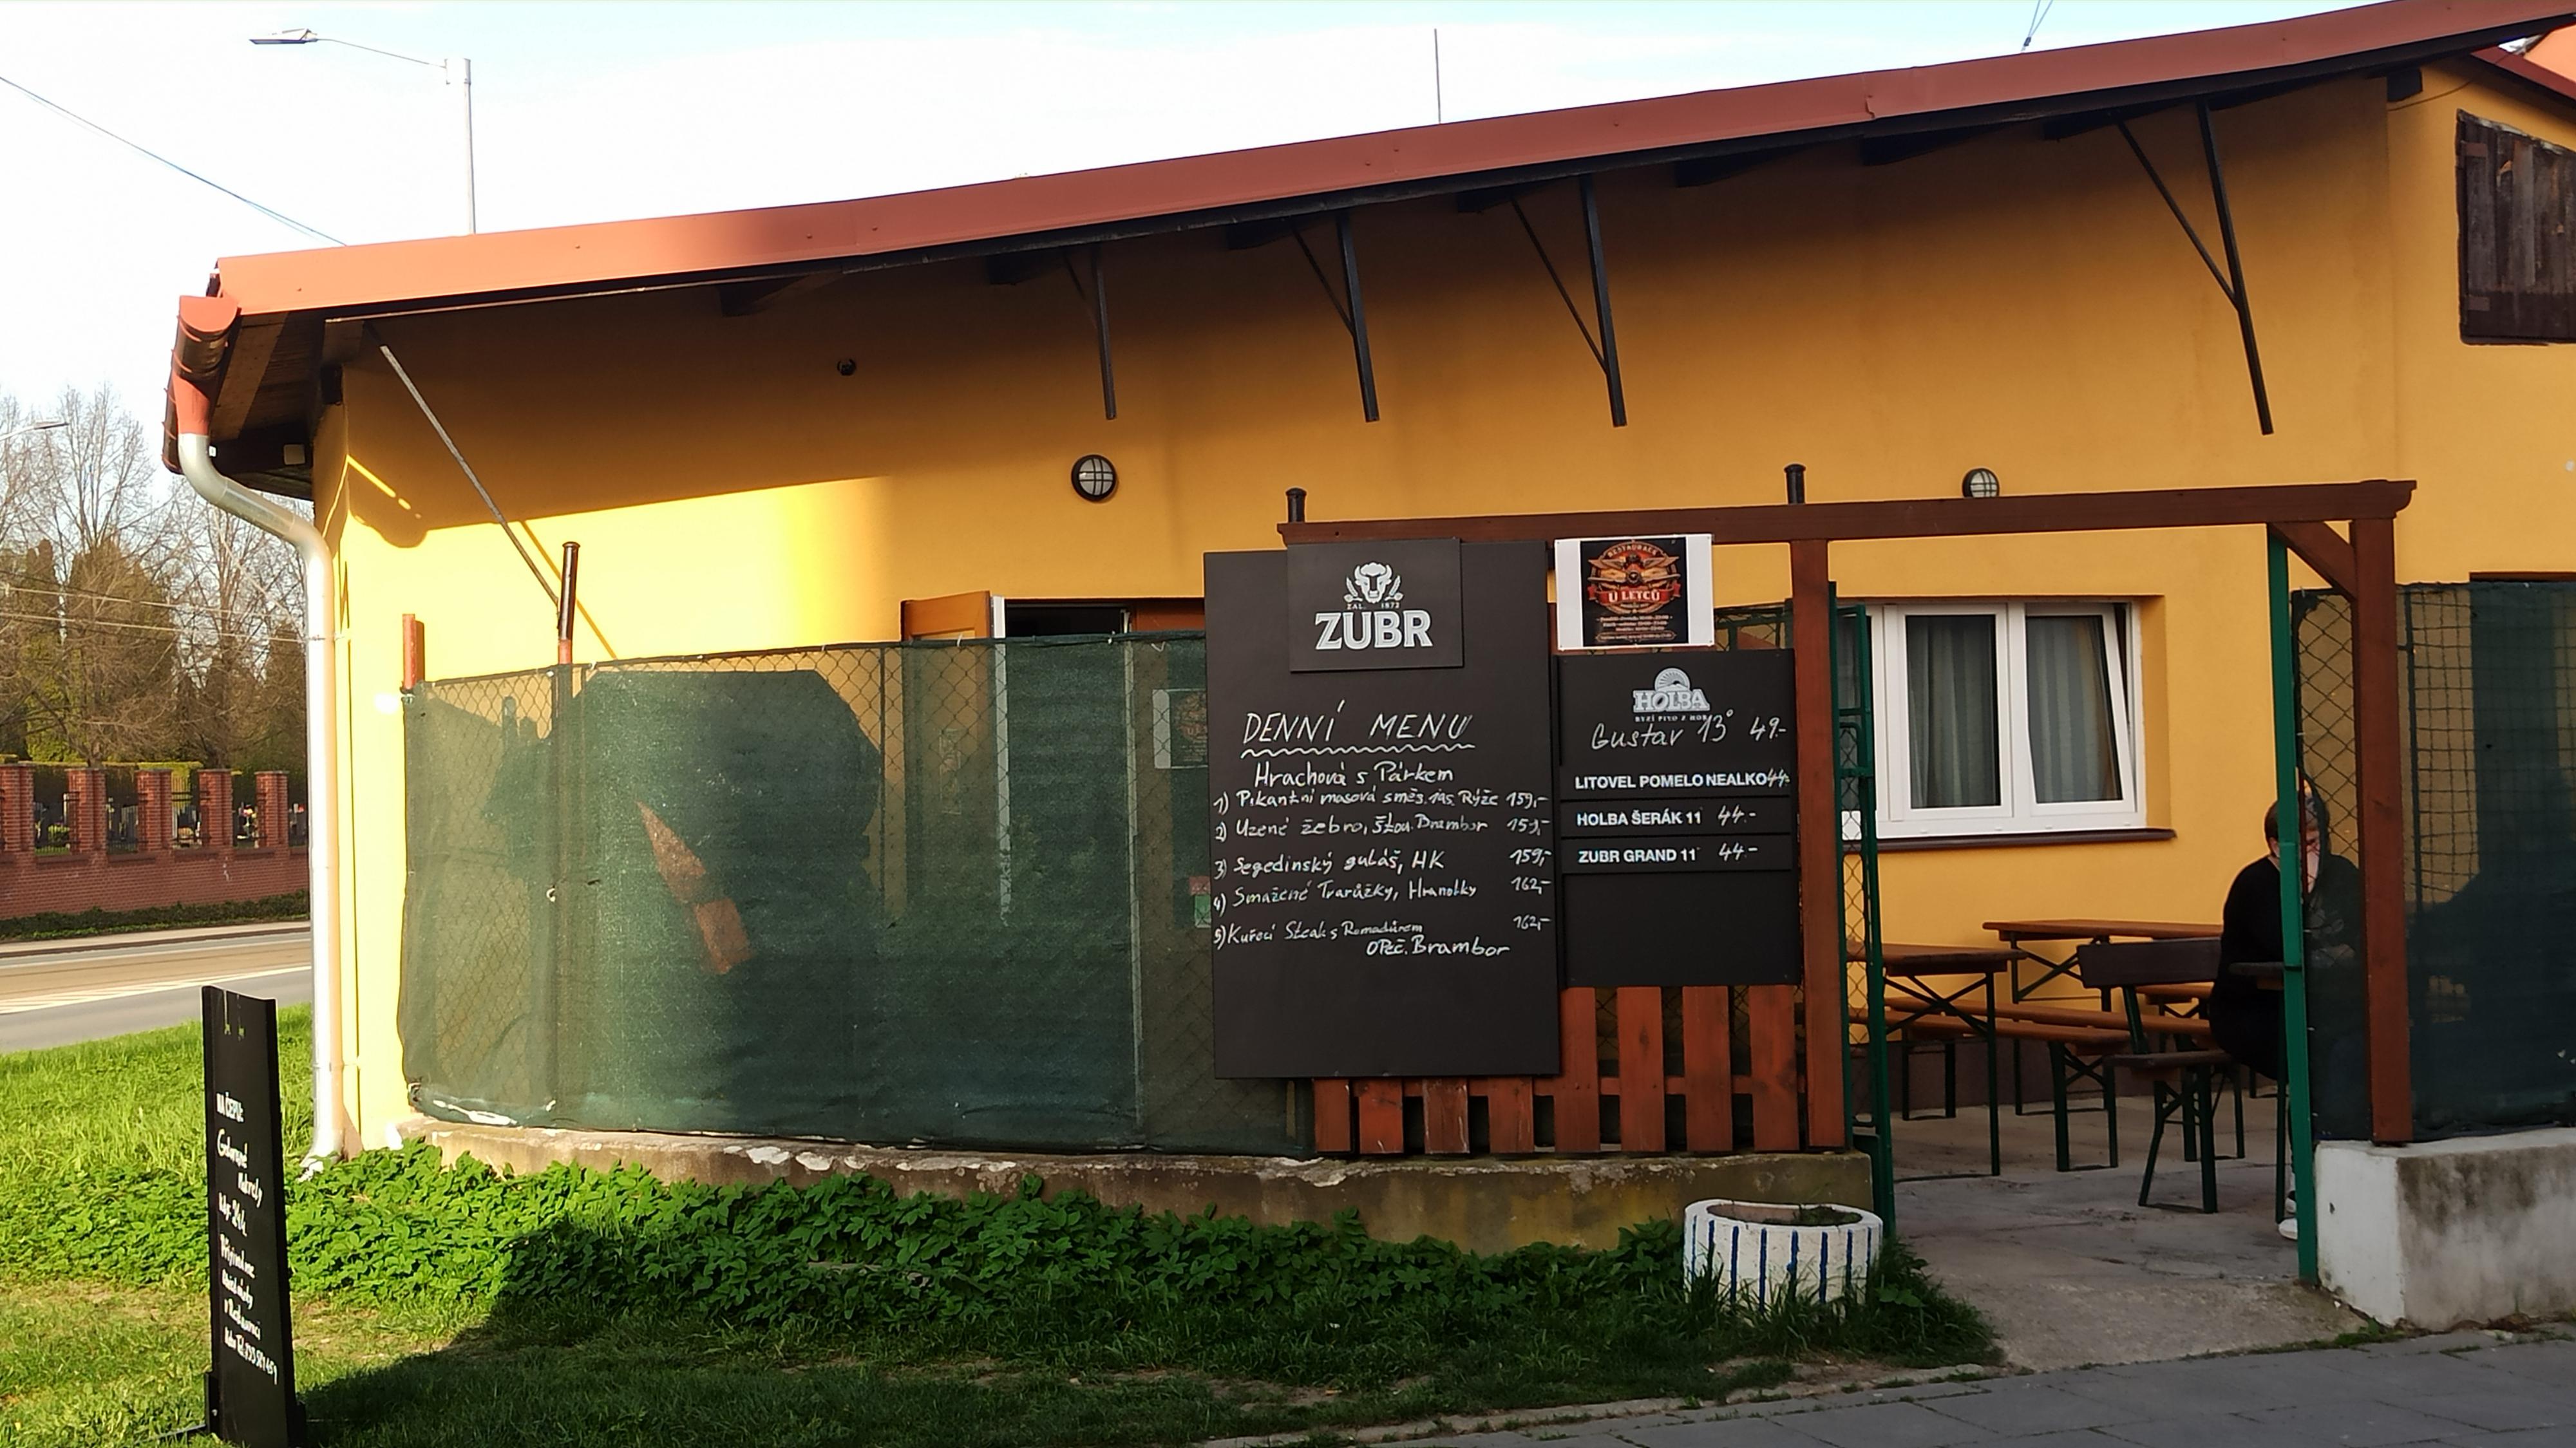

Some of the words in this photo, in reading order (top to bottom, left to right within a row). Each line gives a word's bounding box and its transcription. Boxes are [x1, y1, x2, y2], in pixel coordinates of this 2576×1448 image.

[1608, 590, 1618, 603] U
[1314, 609, 1434, 650] ZUBR
[1633, 688, 1710, 713] HOLBA
[1243, 699, 1345, 744] DENNÍ
[1367, 713, 1473, 740] MENU
[1591, 722, 1683, 749] Gustav
[1255, 760, 1347, 787] Hrachová
[1356, 771, 1368, 784] s
[1374, 760, 1454, 783] Párkem
[1575, 775, 1636, 790] LITOVEL
[1639, 773, 1703, 788] POMELO
[1706, 772, 1767, 787] NEALKO
[1213, 791, 1229, 816] 1)
[1577, 813, 1629, 826] HOLBA
[1631, 808, 1683, 825] ŠERÁK
[1215, 822, 1227, 843] 2)
[1214, 858, 1227, 879] 3)
[1411, 850, 1445, 869] HK
[1578, 849, 1620, 863] ZUBR
[1623, 848, 1677, 862] GRAND
[1213, 893, 1227, 917] 4)
[1411, 934, 1510, 957] Brambor
